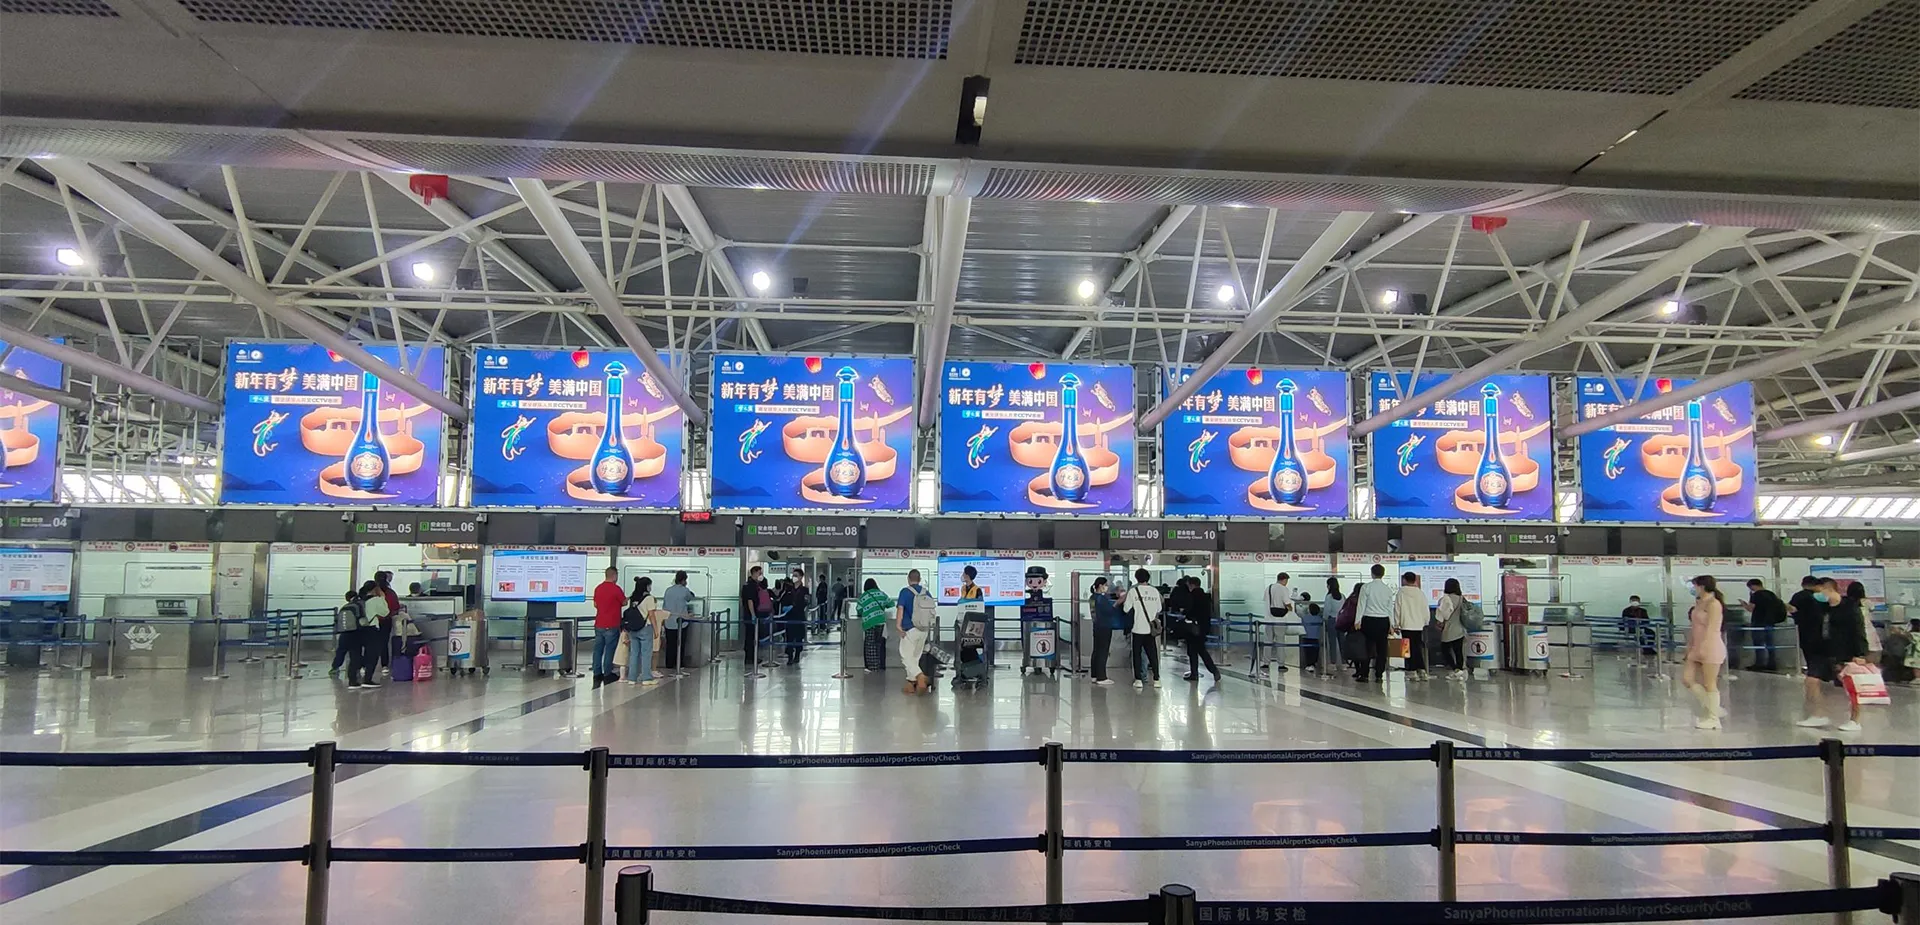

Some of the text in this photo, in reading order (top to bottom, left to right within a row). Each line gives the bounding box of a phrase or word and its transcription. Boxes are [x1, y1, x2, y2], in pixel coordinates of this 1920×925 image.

[234, 367, 358, 393] 新年有梦 美满中国
[483, 372, 602, 398] 新年有梦 美满中国
[721, 377, 834, 402] 新年有梦 美满中国
[949, 383, 1058, 408] 新年有梦 美满中国
[1178, 389, 1275, 413] 年有梦 美满中国
[1434, 400, 1480, 416] 美满中国
[1640, 406, 1685, 421] 满中国
[52, 517, 67, 527] 04
[460, 522, 475, 532] 06
[397, 523, 412, 533] 05
[786, 525, 799, 535] 07
[844, 526, 858, 536] 08
[1146, 529, 1159, 539] 09
[1203, 530, 1216, 539] 10
[1491, 534, 1502, 543] 11
[1544, 534, 1556, 543] 12
[1815, 538, 1827, 547] 13
[1862, 539, 1874, 547] 14
[778, 753, 961, 765] SanyaPhoenixInternationalAirportSecurityCheck
[1191, 750, 1362, 761] SanyaPhoenixInternationalAirportSecurityCheck
[608, 757, 698, 766] 凤凰国际机场安检
[1185, 836, 1358, 848] SanyaPhoenixInternationalAirportSecurityCheck
[605, 849, 697, 858] 凤凰国际机场安检
[777, 842, 961, 857] SanyaPhoenixInternationalAirportSecurityCheck
[1200, 907, 1307, 921] 国际机场安检
[1444, 900, 1751, 921] SanyaPhoenixInternationalAirportSecurityCheck
